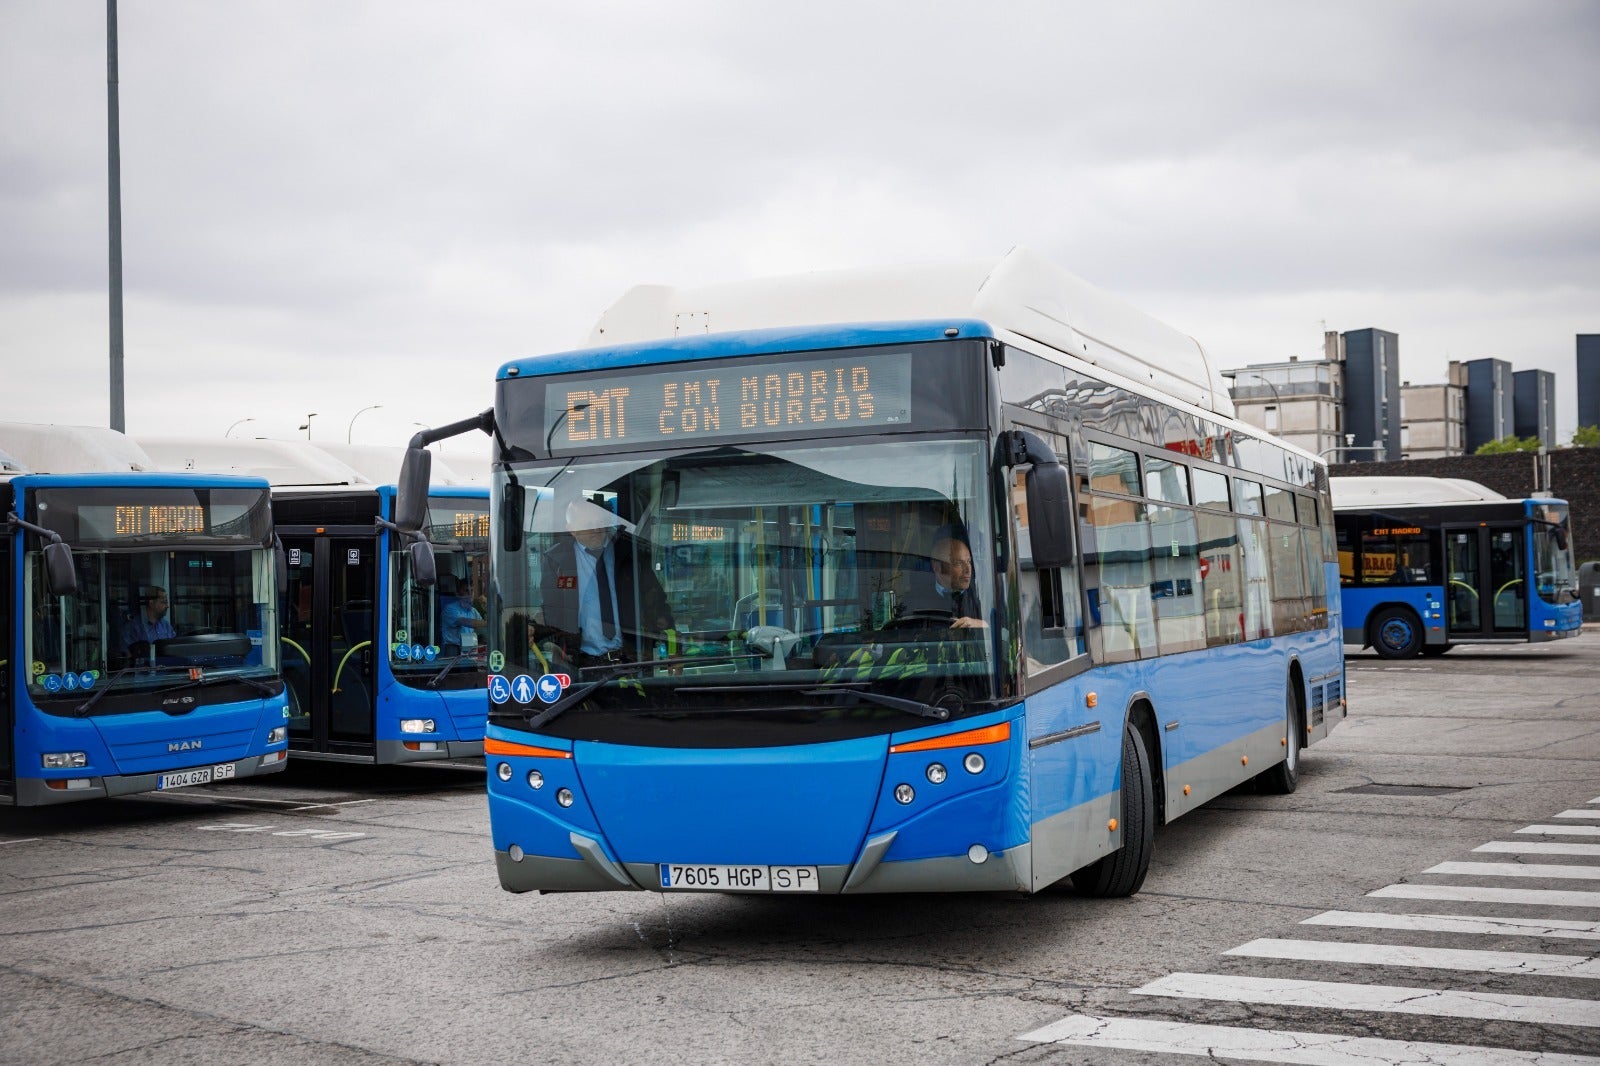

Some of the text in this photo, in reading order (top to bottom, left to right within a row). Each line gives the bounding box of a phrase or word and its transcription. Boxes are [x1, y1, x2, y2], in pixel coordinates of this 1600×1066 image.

[664, 366, 868, 407] EMT MADRID
[567, 387, 629, 441] EMT
[659, 393, 874, 434] CON BURGOS
[115, 505, 204, 534] EMT MADRID
[455, 513, 475, 537] EMT
[1373, 527, 1421, 536] EMT MADRID
[168, 740, 202, 752] MAN
[165, 771, 209, 787] 1404 GZR
[673, 867, 762, 887] 7605 HGP
